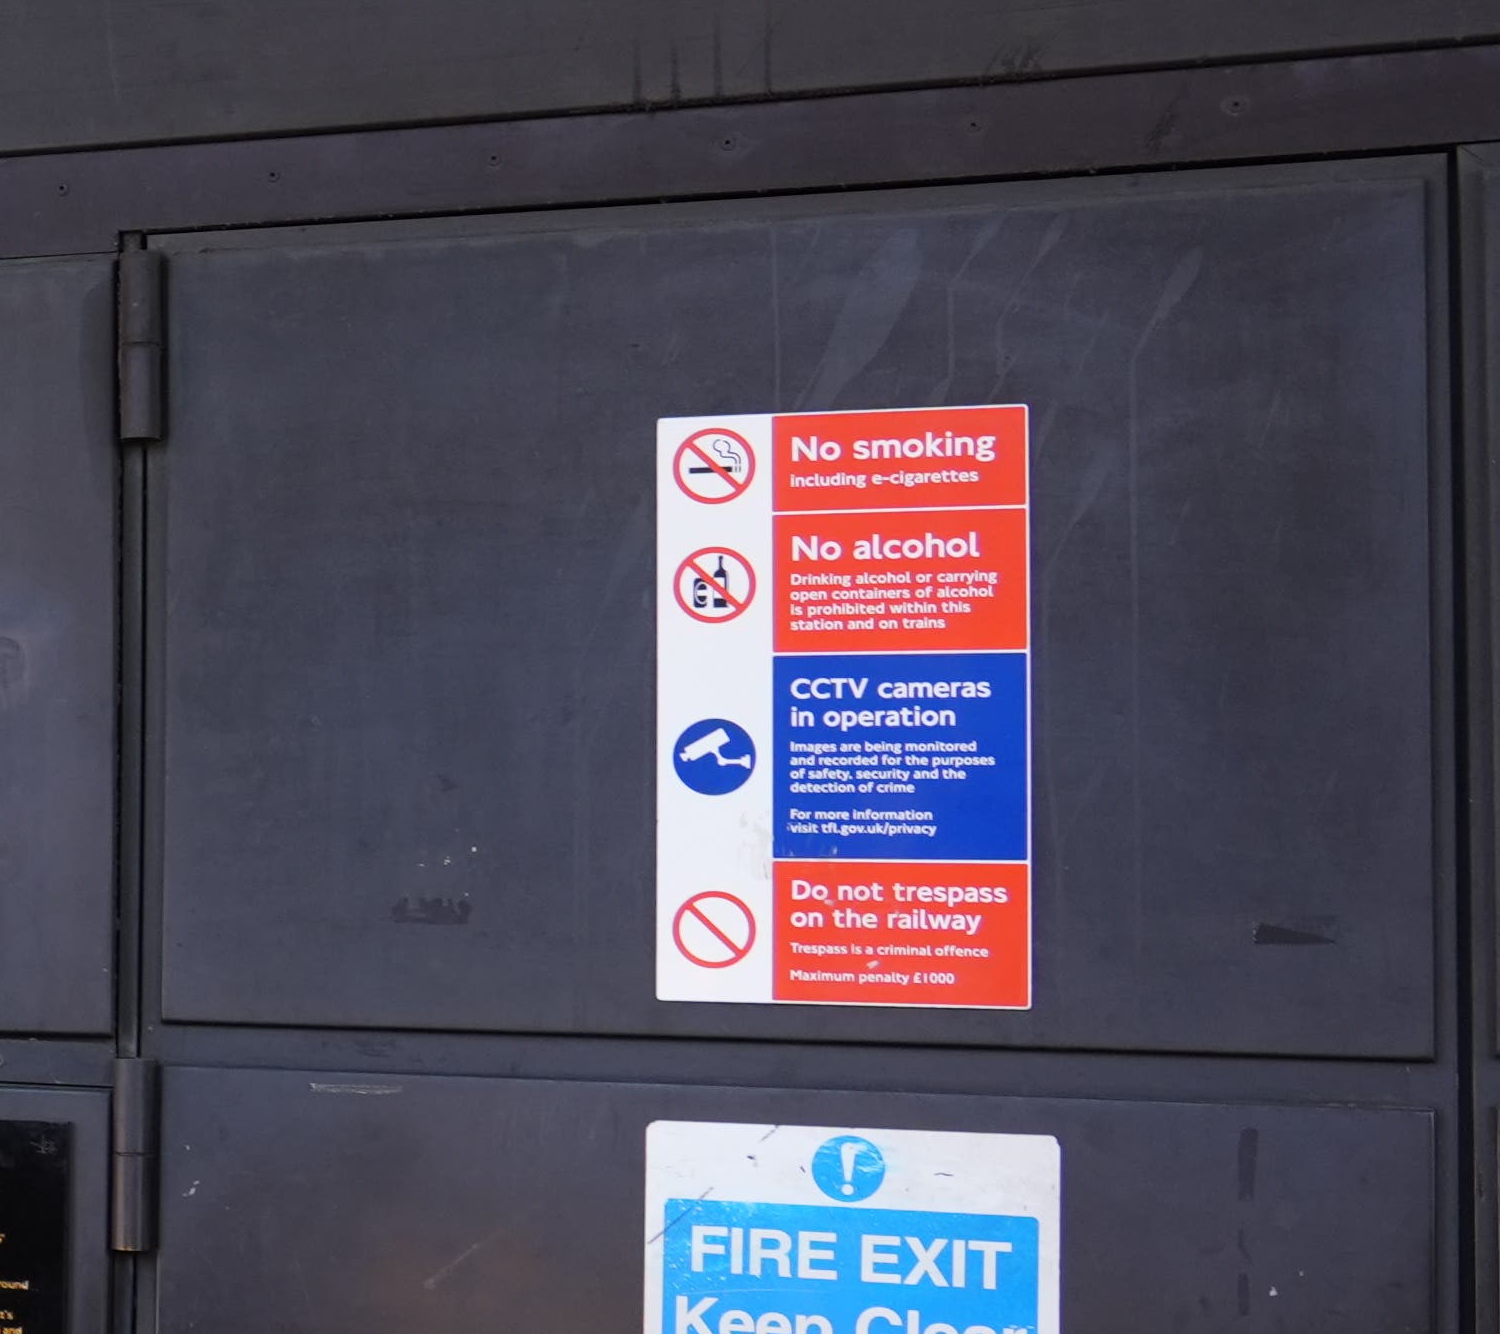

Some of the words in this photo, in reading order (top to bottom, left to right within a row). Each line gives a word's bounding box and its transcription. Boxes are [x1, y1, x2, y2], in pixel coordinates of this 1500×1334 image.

[791, 435, 841, 462] No
[853, 431, 996, 462] smoking
[790, 472, 867, 489] including
[871, 469, 979, 487] e-cigarettes
[791, 535, 842, 561] No
[853, 531, 979, 560] alcohol
[790, 572, 852, 587] Drinking
[855, 571, 911, 584] alcohol
[915, 573, 933, 583] or
[936, 570, 998, 585] carrying
[789, 590, 828, 603] open
[831, 587, 911, 600] containers
[914, 585, 933, 598] of
[936, 584, 994, 598] alcohol
[790, 601, 804, 616] is
[807, 602, 885, 617] prohibited
[888, 601, 937, 614] within
[940, 600, 971, 613] this
[790, 616, 844, 631] station
[846, 617, 874, 630] and
[878, 619, 899, 630] on
[901, 616, 946, 629] trains
[790, 677, 868, 699] CCTV
[877, 681, 991, 699] cameras
[790, 706, 815, 727] in
[822, 706, 956, 731] operation
[789, 741, 837, 755] Images
[839, 742, 862, 752] are
[864, 740, 902, 755] being
[904, 740, 977, 752] monitored
[789, 754, 815, 766] and
[818, 754, 879, 766] recorded
[881, 753, 902, 766] for
[904, 754, 929, 766] the
[931, 756, 995, 768] purposes
[789, 767, 806, 779] of
[855, 768, 910, 782] security
[912, 767, 939, 780] and
[941, 767, 966, 779] the
[789, 781, 856, 793] detection
[857, 781, 874, 793] of
[875, 781, 915, 793] crime
[789, 808, 812, 820] For
[814, 810, 850, 820] more
[852, 808, 933, 821] information
[788, 822, 819, 834] visit
[820, 821, 937, 837] tfl.gov.uk/privacy
[791, 879, 828, 901] Do
[837, 882, 884, 901] not
[892, 883, 1008, 907] trespass
[790, 911, 824, 928] on
[832, 907, 878, 929] the
[887, 908, 982, 935] railway
[790, 941, 848, 956] Trespass
[850, 943, 862, 955] is
[864, 945, 874, 955] a
[876, 944, 932, 956] criminal
[934, 944, 989, 958] offence
[789, 969, 855, 982] Maximum
[858, 971, 910, 986] penalty
[912, 971, 955, 984] £1000
[690, 1225, 838, 1281] FIRE
[860, 1233, 1012, 1290] EXIT
